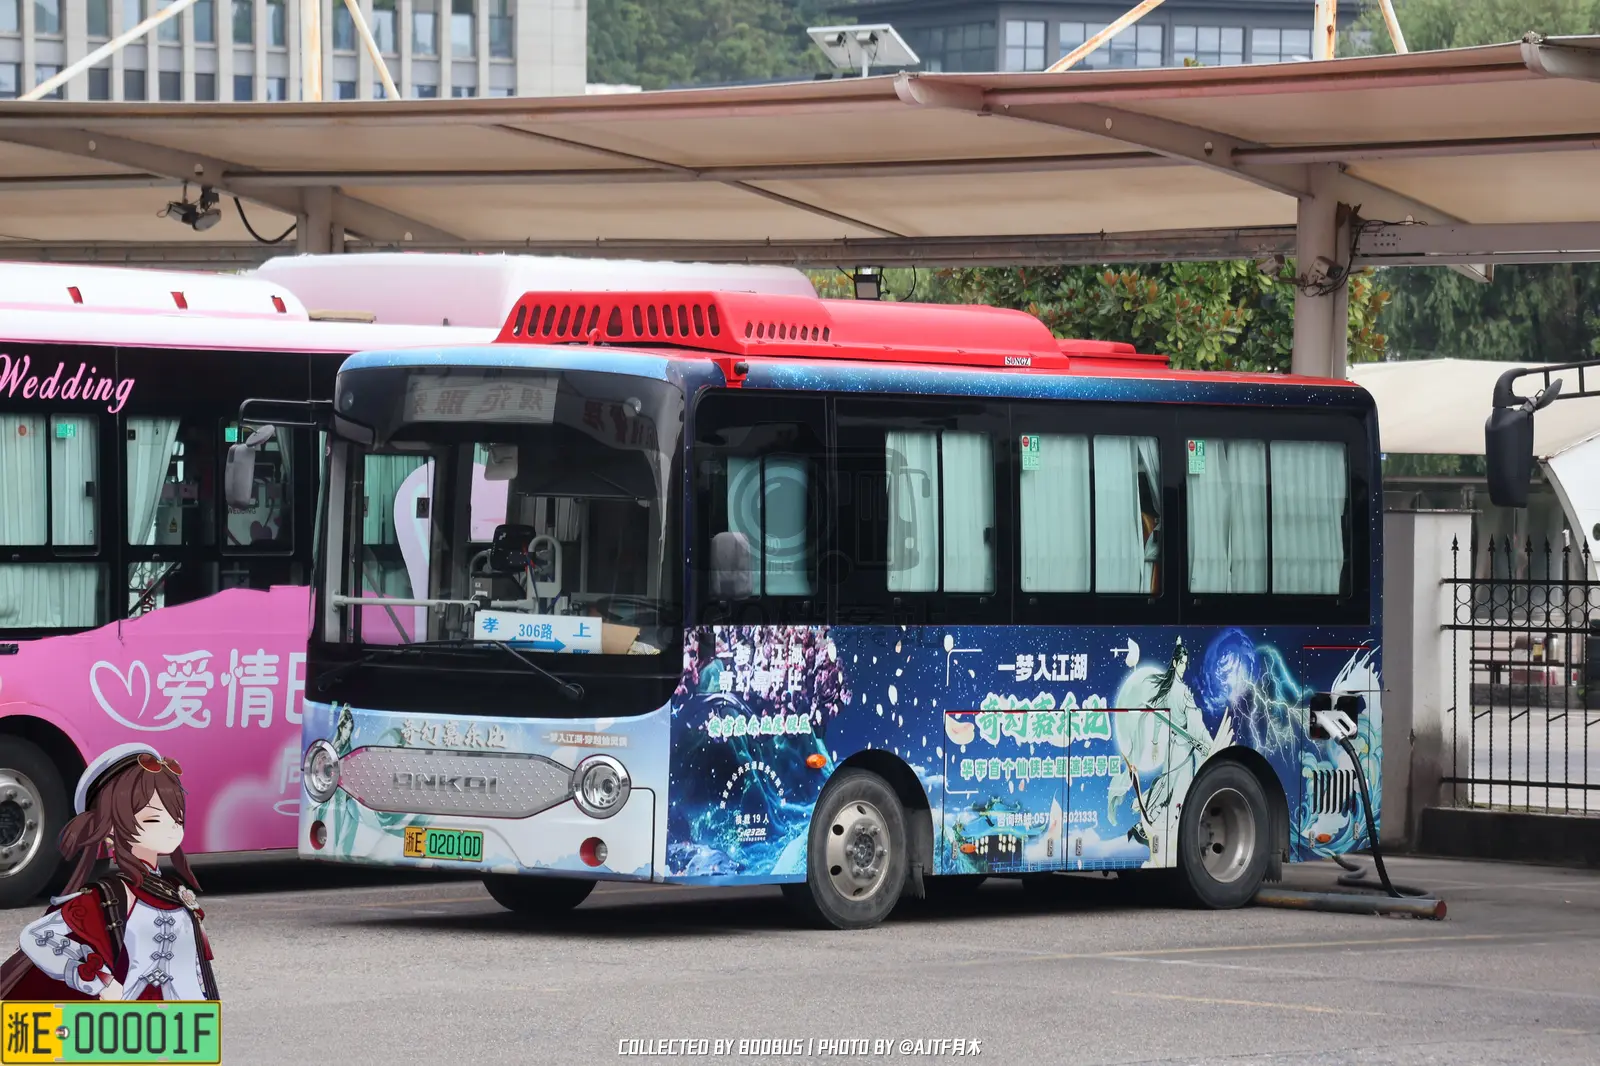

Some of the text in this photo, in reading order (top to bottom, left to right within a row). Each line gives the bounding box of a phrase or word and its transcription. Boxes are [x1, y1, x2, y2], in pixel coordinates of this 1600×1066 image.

[1006, 356, 1029, 366] SONGZ
[0, 353, 135, 414] Wedding
[518, 623, 553, 640] 306路
[998, 653, 1088, 682] 一梦入江湖
[977, 692, 1111, 744] 奇幻嘉乐比
[393, 771, 498, 794] ANKAI
[752, 814, 761, 823] 19
[762, 813, 770, 824] 人
[429, 833, 481, 857] 02010D
